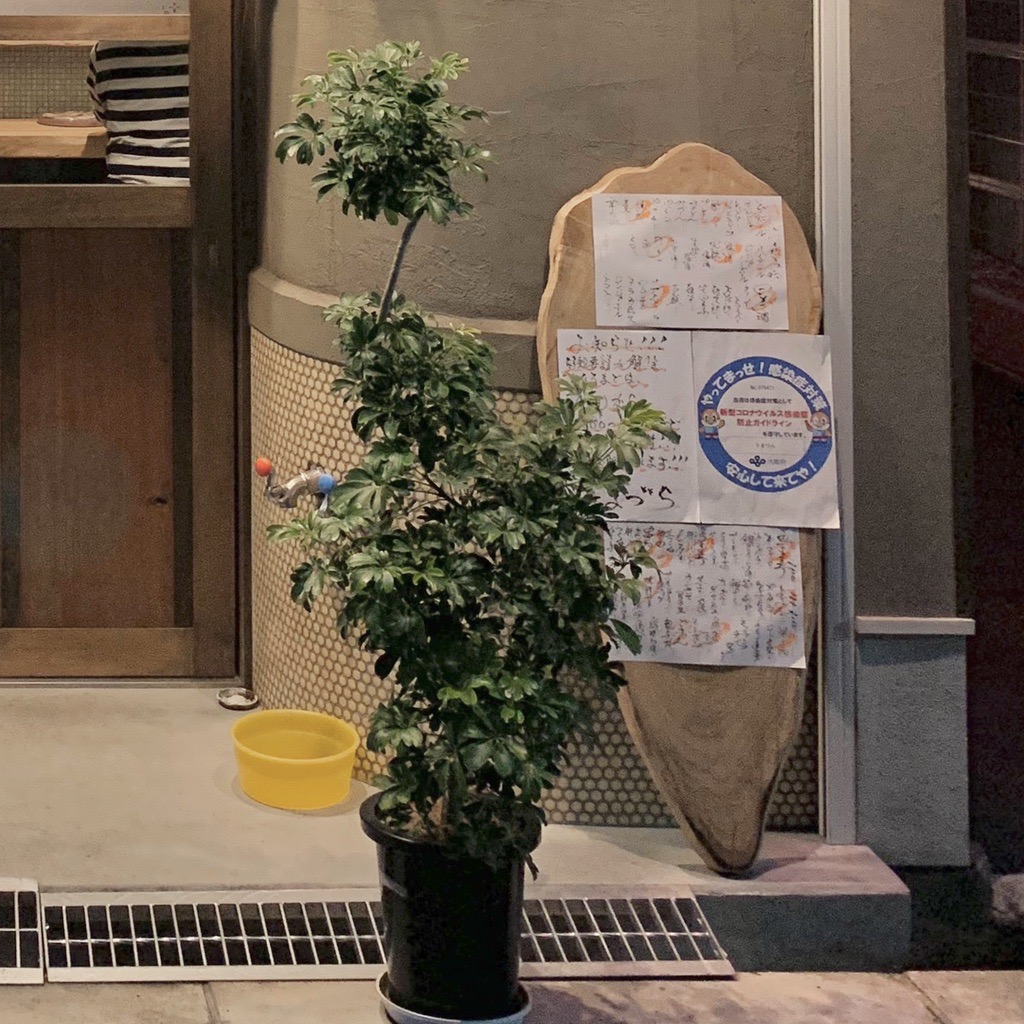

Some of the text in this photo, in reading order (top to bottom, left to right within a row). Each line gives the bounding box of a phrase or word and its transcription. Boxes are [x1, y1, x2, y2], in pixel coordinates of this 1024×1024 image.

[720, 408, 809, 418] 新型コロナウイルス感染症
[736, 418, 792, 427] 防止ガイドライン
[726, 461, 817, 488] 安心して来てや！
